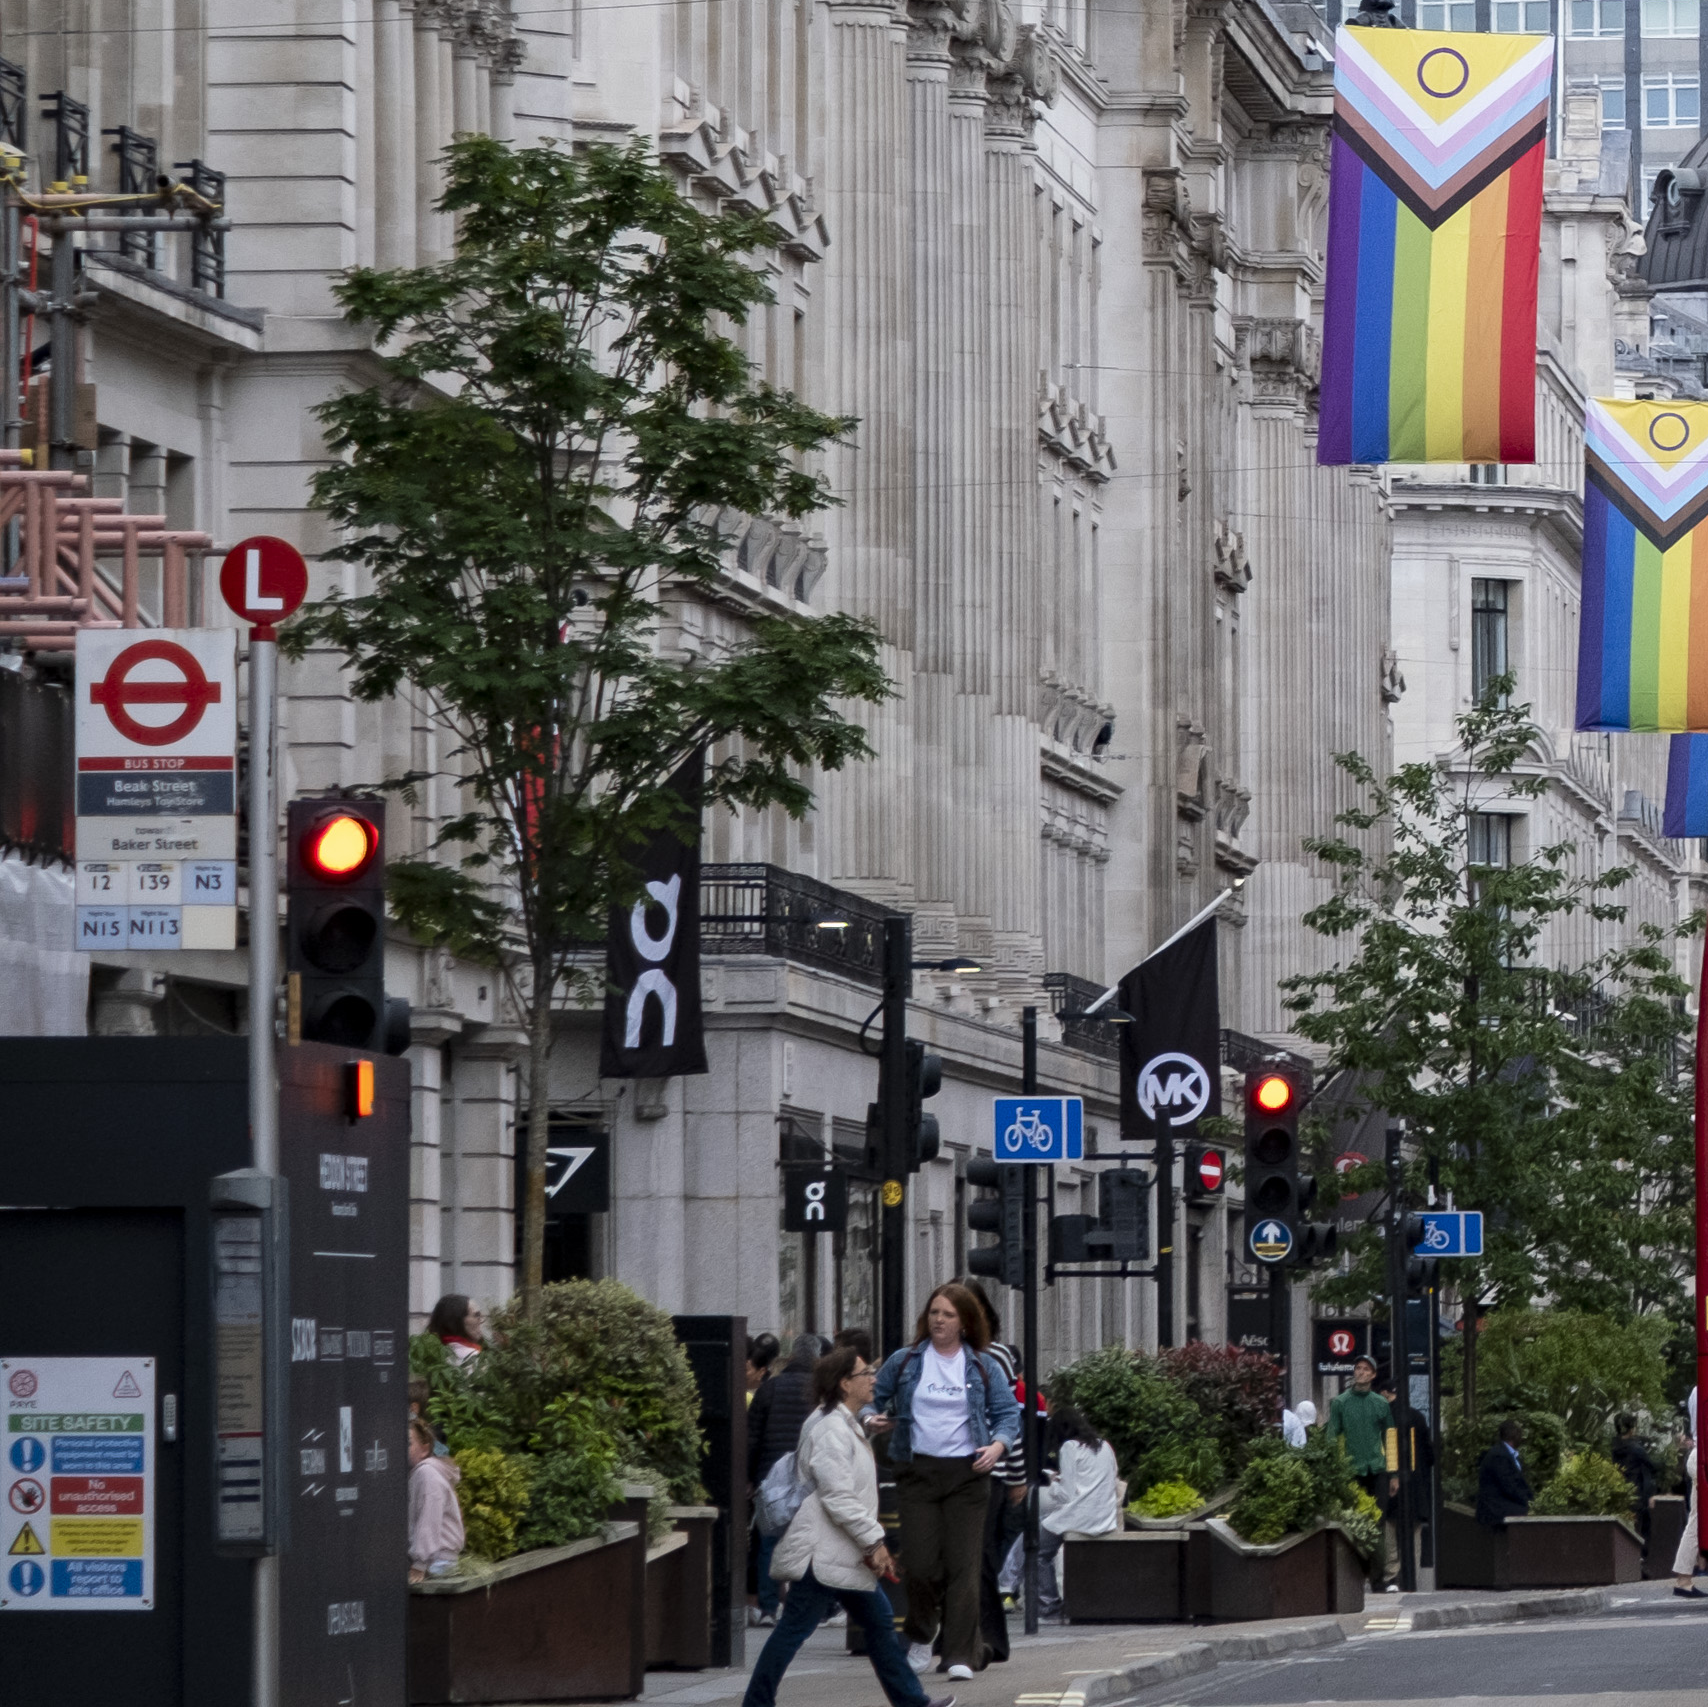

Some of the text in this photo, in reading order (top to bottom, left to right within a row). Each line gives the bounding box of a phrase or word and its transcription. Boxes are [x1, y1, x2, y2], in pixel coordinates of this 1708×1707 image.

[246, 549, 284, 610] L
[124, 758, 185, 769] BUS STOP
[114, 780, 196, 793] Beak Street
[106, 797, 151, 808] Hamleys
[174, 797, 205, 806] Store
[112, 839, 198, 850] Baker Street
[92, 875, 111, 890] 12
[139, 875, 170, 890] 139
[195, 874, 222, 890] N3
[83, 921, 120, 937] N15
[129, 919, 179, 935] N113
[1146, 1072, 1201, 1106] MK
[21, 1415, 132, 1430] SITE SAFETY
[88, 1479, 106, 1490] No
[58, 1491, 136, 1501] unauthorised
[76, 1504, 118, 1513] access
